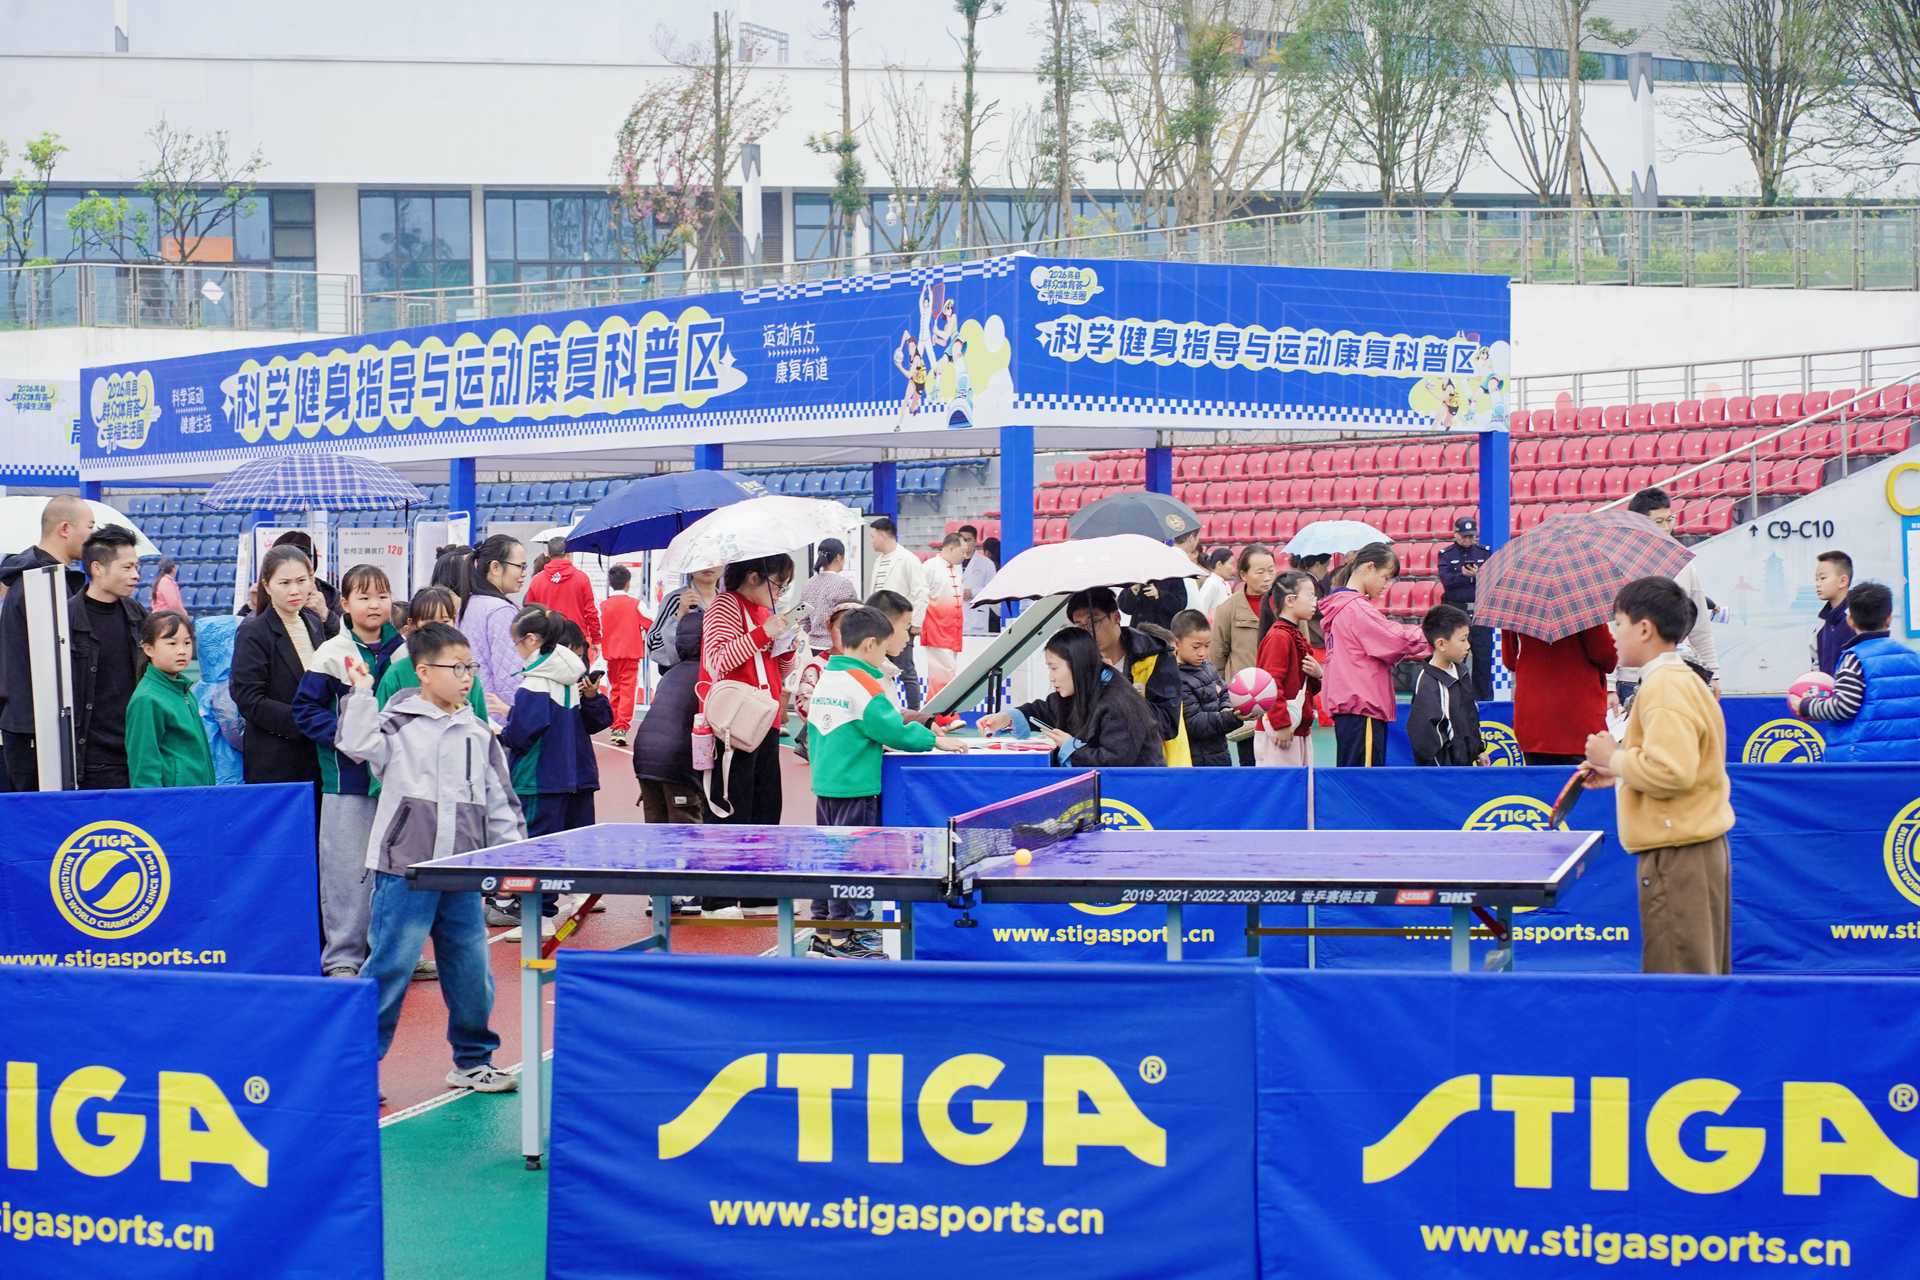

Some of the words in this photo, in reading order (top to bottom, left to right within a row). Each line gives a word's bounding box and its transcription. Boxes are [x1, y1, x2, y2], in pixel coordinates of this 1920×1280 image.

[763, 320, 816, 348] 运动有方
[1052, 321, 1477, 374] 科学健身指导与运动康复科普区
[236, 320, 723, 430] 科学健身指导与运动康复科普区
[775, 356, 829, 384] 康复有道
[172, 386, 204, 407] 科学运动
[180, 414, 212, 433] 健康生活
[1768, 520, 1834, 539] C9-C10
[830, 885, 874, 899] T2023
[992, 924, 1215, 945] www.stigasport.cn
[0, 1201, 214, 1252] igasports.cn
[709, 1196, 1104, 1237] www.stigasports.cn
[1420, 1223, 1851, 1267] www.stigasports.cn
